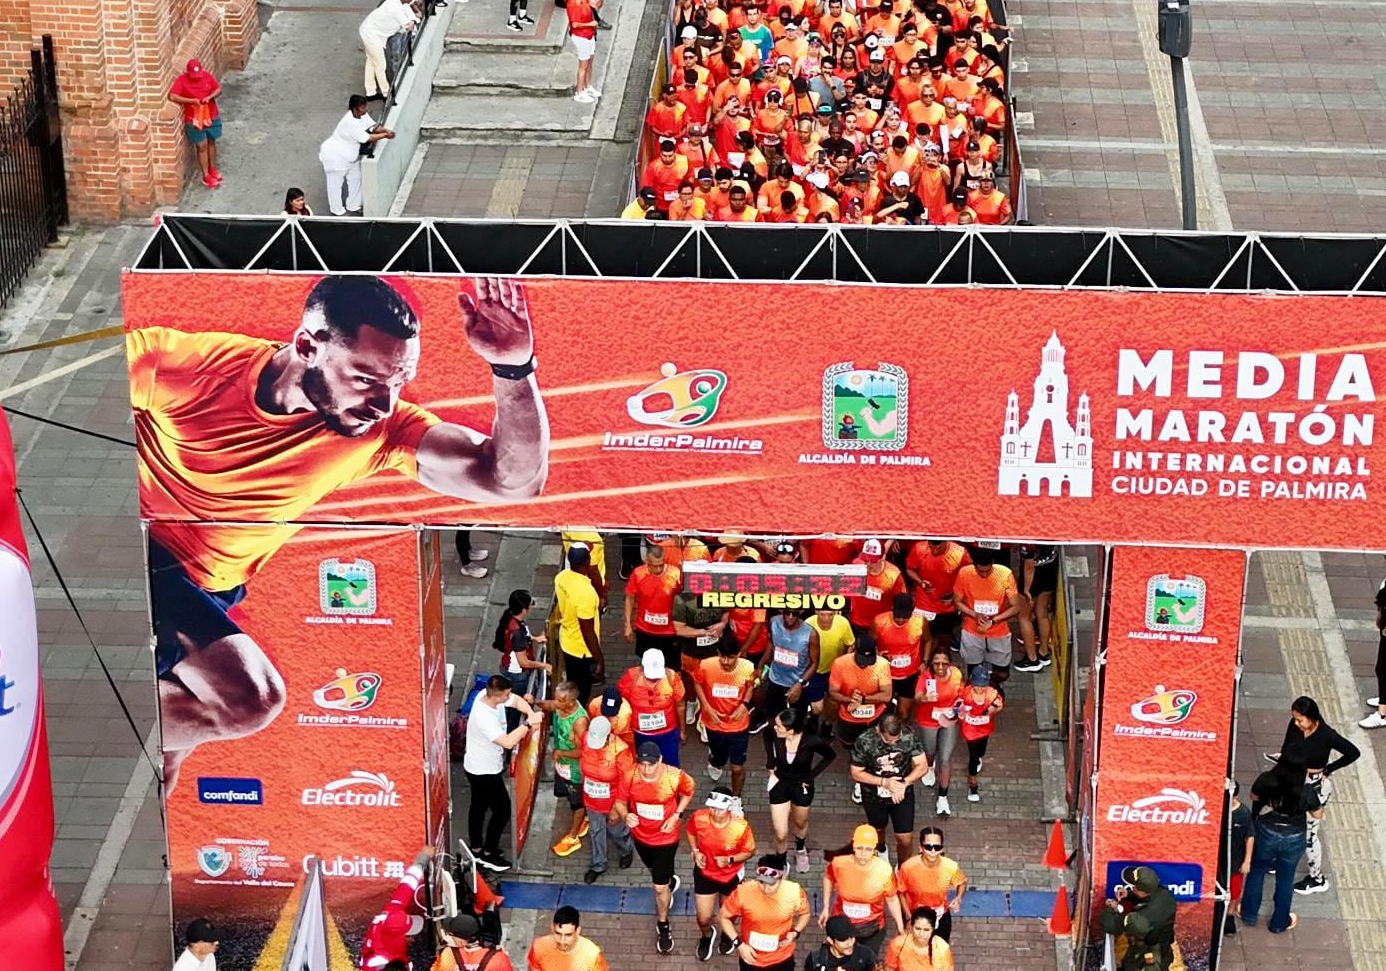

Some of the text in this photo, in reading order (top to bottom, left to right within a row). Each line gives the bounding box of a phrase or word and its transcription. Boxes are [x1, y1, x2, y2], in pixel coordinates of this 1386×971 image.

[1116, 348, 1377, 402] MEDIA
[1114, 405, 1375, 446] MARATÓN
[602, 431, 763, 450] ImderPalmira
[798, 452, 931, 467] ALCALDÍA DE PALMIRA
[1112, 450, 1371, 475] INTERNACIONAL
[1110, 475, 1367, 500] CIUDAD DE PALMIRA
[701, 592, 846, 610] REGRESIVO
[358, 618, 393, 626] PALMIRA
[1127, 631, 1218, 644] ALCALDÍA DE PALMIRA
[298, 713, 408, 726] ImderPalmira
[1114, 723, 1217, 739] ImderPalmira
[203, 790, 258, 802] comfandi
[301, 788, 401, 807] Electrolit
[1107, 805, 1211, 825] Electrolit
